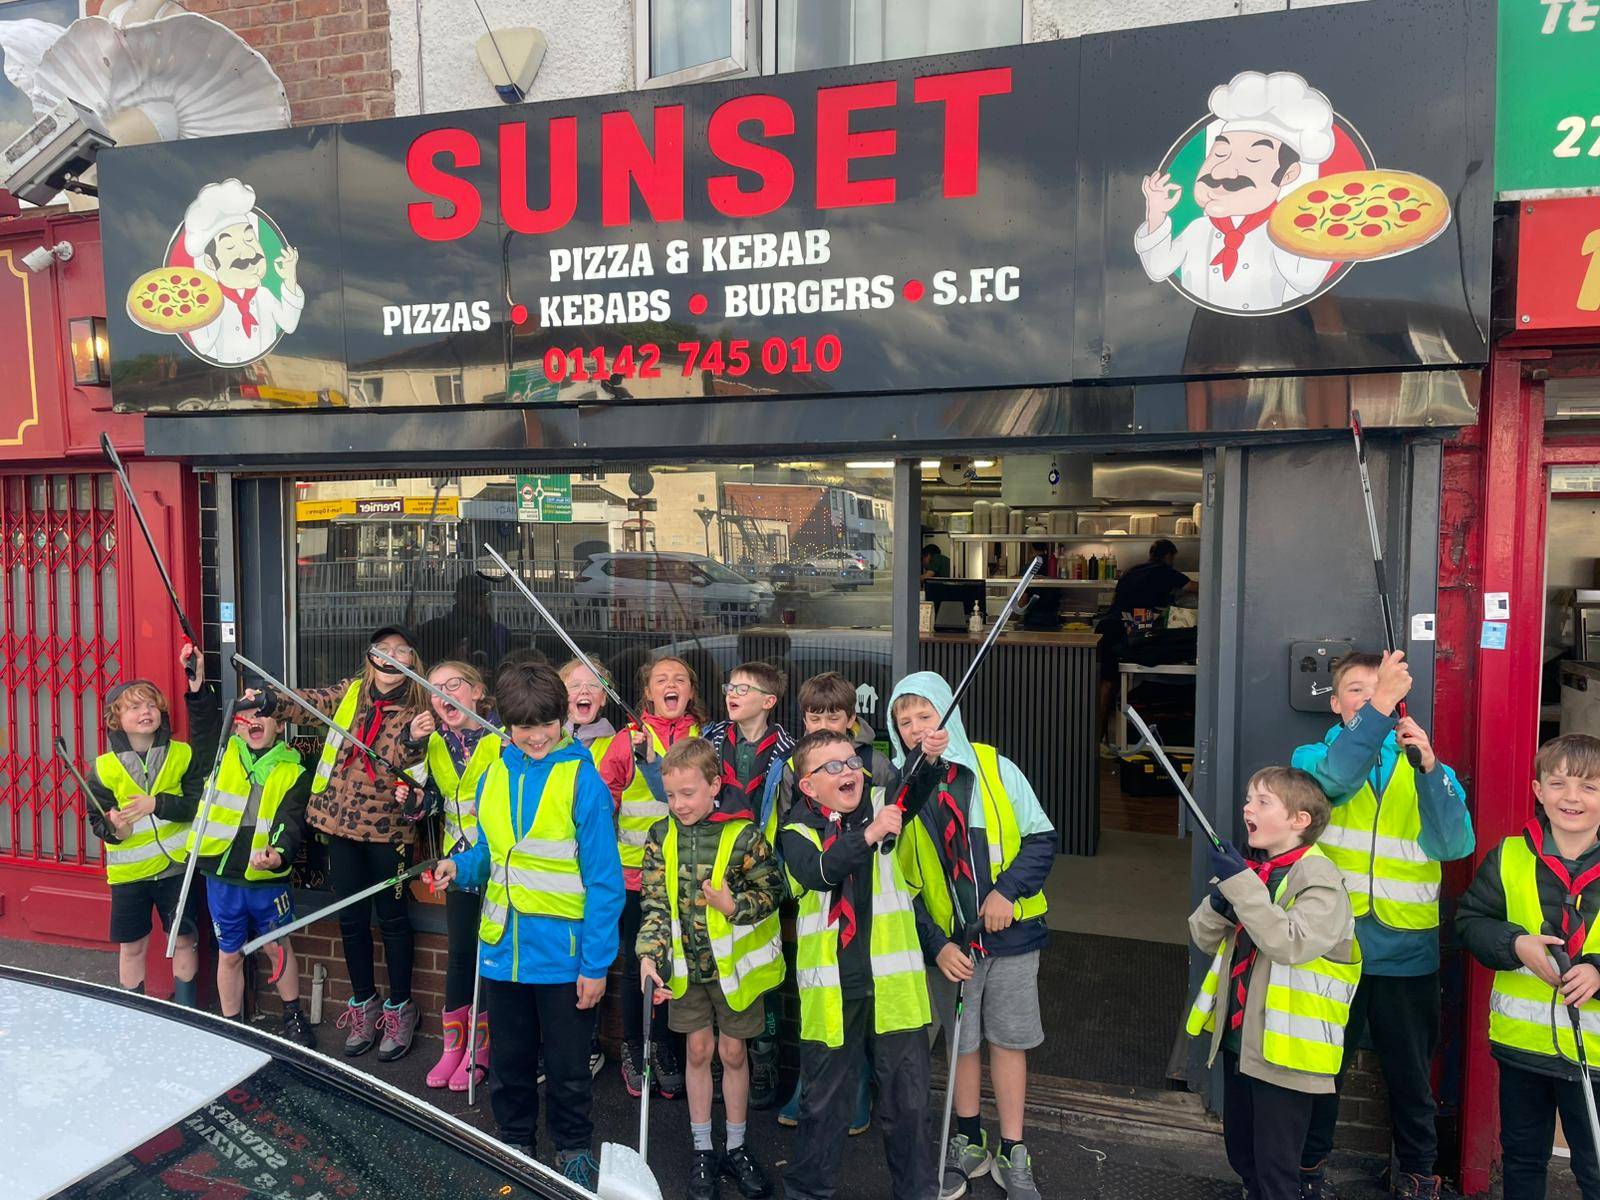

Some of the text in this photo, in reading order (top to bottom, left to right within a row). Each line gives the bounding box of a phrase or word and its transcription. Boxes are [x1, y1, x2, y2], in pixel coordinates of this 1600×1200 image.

[406, 67, 1013, 242] SUNSET
[549, 228, 832, 283] PIZZA & KEBAB
[381, 265, 1021, 336] PIZZAS KEBABS BURGERS S.F.C
[542, 334, 843, 384] 01142 745 010
[273, 890, 291, 918] 10
[394, 862, 405, 900] adas
